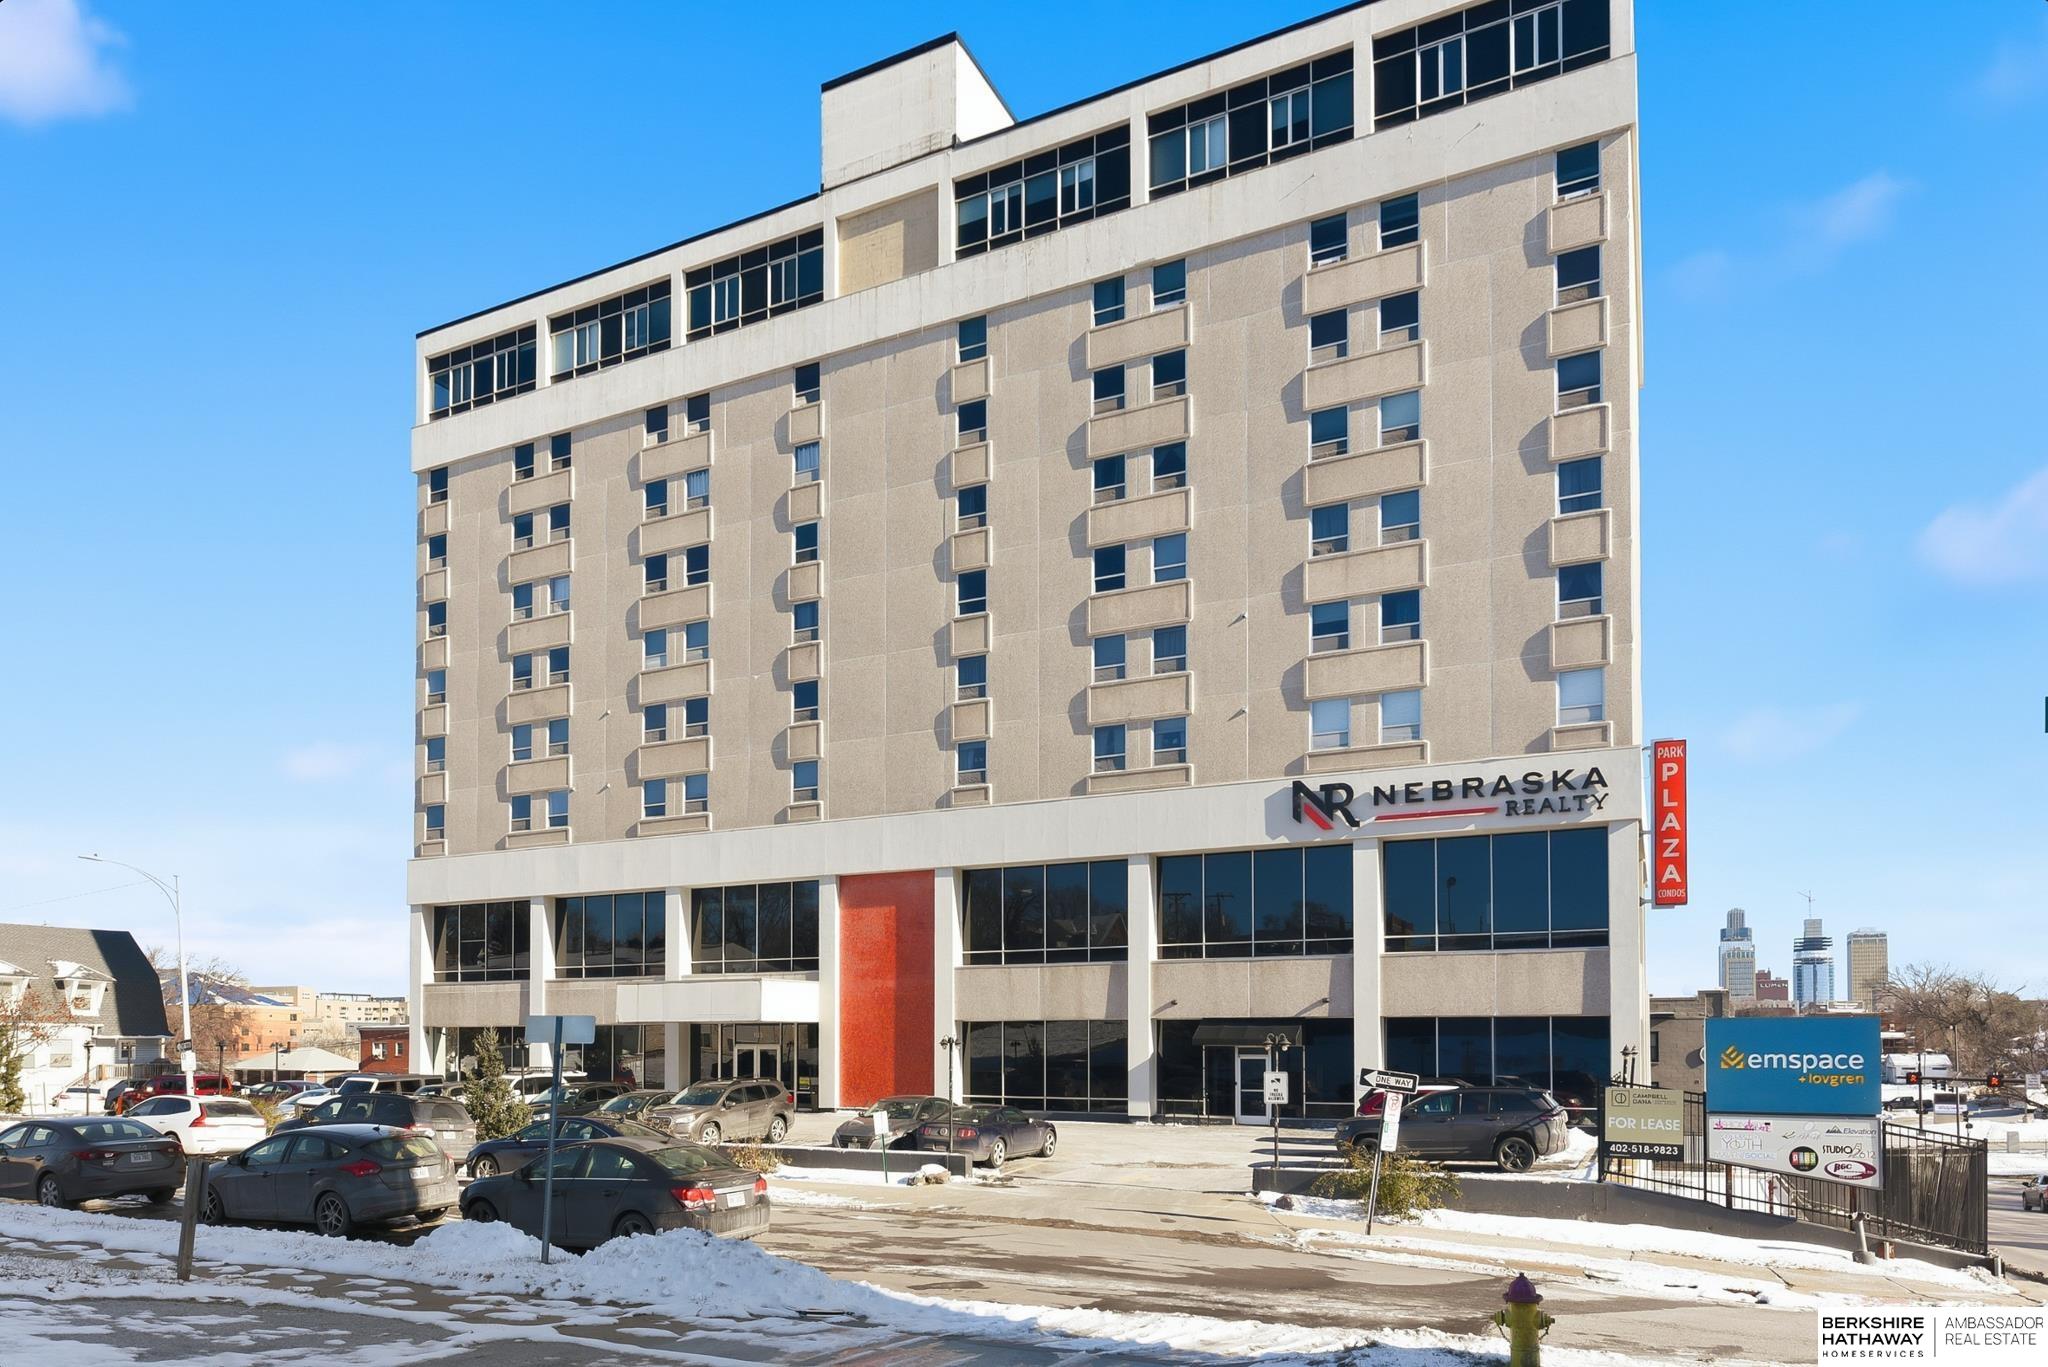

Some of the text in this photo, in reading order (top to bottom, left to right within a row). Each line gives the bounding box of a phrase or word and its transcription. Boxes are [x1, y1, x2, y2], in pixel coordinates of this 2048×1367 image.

[1657, 745, 1684, 759] PARK
[1373, 766, 1609, 806] NEBRASKA
[1505, 792, 1609, 817] REALTY
[1660, 762, 1682, 884] PLAZA
[1657, 888, 1686, 898] CONDOS
[1747, 1053, 1864, 1073] emspace
[1376, 1075, 1411, 1087] ONE WAY
[1608, 1116, 1681, 1131] FOR LEASE
[1843, 1127, 1877, 1136] Elevation
[1609, 1143, 1679, 1155] 402-518-9823
[1722, 1136, 1763, 1151] YOUTH
[1822, 1144, 1876, 1159] STUDIO 612
